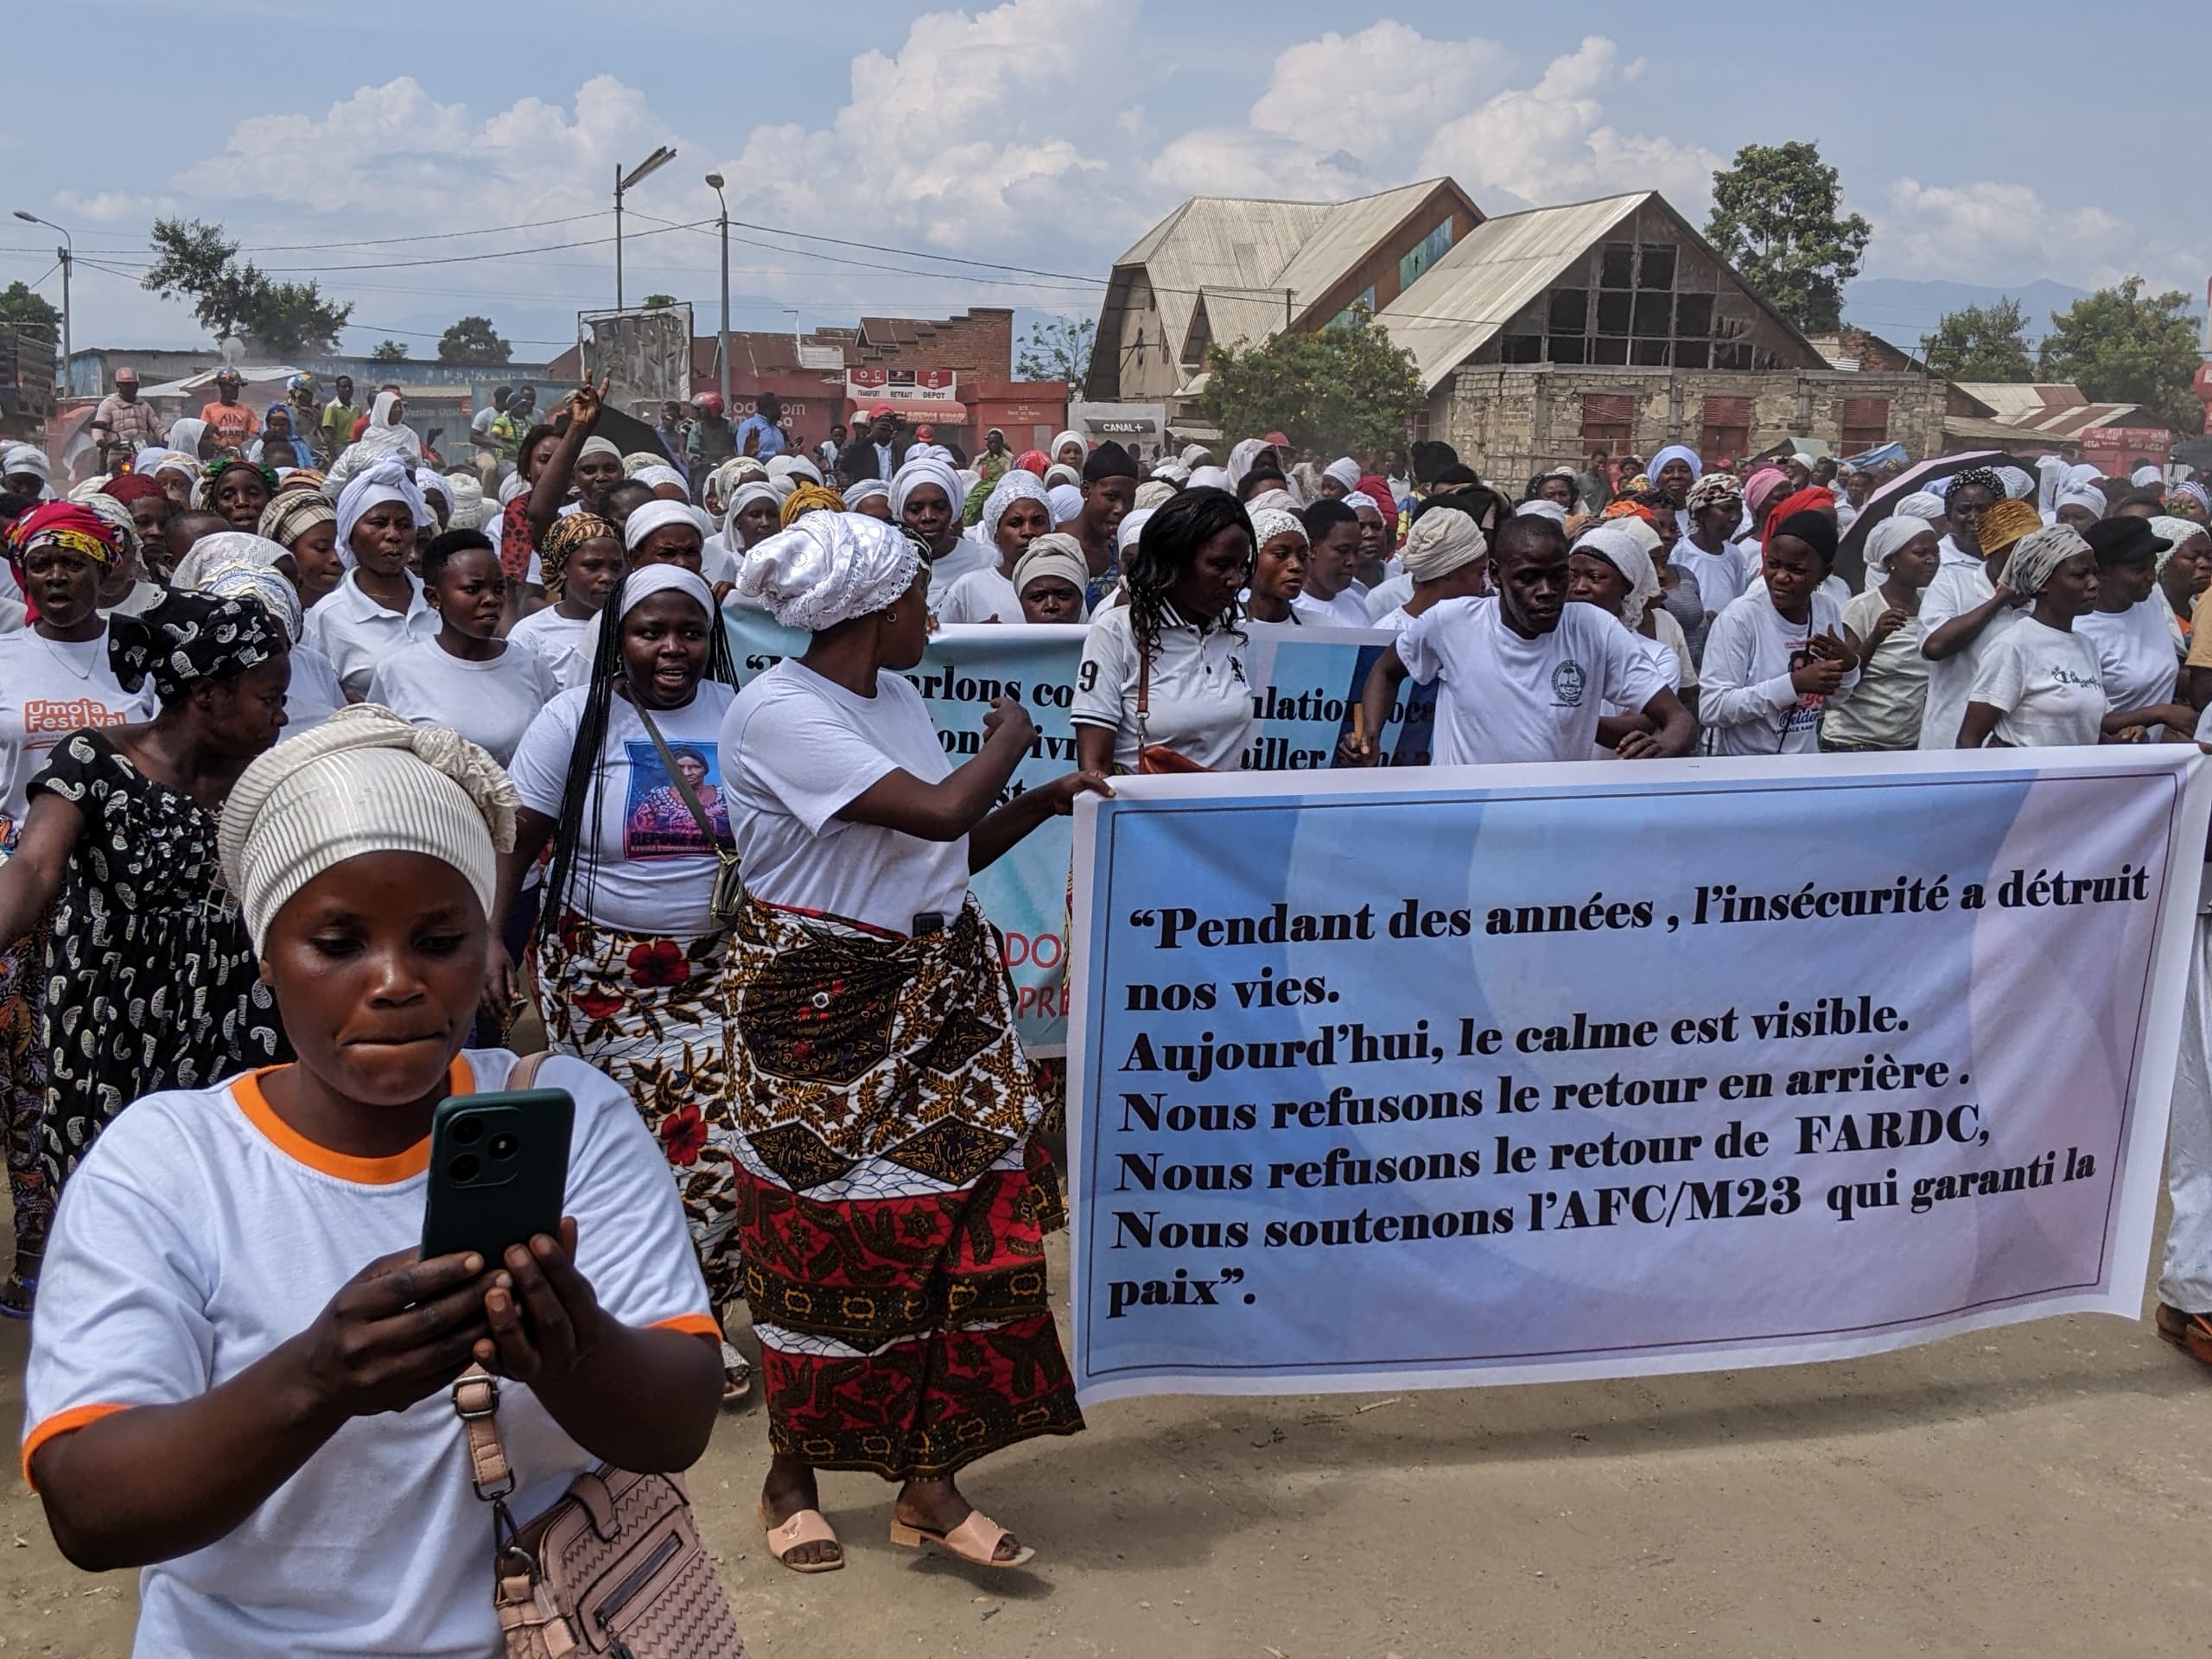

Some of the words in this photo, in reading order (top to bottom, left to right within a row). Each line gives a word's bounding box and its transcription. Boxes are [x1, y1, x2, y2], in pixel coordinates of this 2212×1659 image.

[1103, 423, 1144, 433] CANAL+
[1078, 660, 1099, 692] 9
[29, 701, 104, 721] Umoja
[1129, 902, 1376, 950] “Pendant
[1389, 899, 1471, 939] des
[1485, 892, 1654, 935] années
[1691, 874, 1949, 925] l’insécurité
[1960, 883, 1986, 910] a
[1998, 863, 2150, 908] détruit
[1123, 982, 1217, 1012] nos
[1230, 966, 1340, 1009] vies.
[1116, 1019, 1444, 1083] Aujourd’hui,
[1456, 1018, 1503, 1057] le
[1516, 1012, 1658, 1053] calme
[1670, 1007, 1739, 1046] est
[1750, 995, 1909, 1040] visible.
[1116, 1092, 1257, 1133] Nous
[1270, 1086, 1483, 1129] refusons
[1496, 1075, 1540, 1115] le
[1551, 1072, 1708, 1110] retour
[1719, 1073, 1773, 1101] en
[1785, 1053, 1949, 1096] arrière
[1112, 1152, 1253, 1192] Nous
[1266, 1147, 1480, 1190] refusons
[1493, 1135, 1536, 1175] le
[1548, 1131, 1702, 1171] retour
[1714, 1120, 1769, 1160] de
[1795, 1104, 1990, 1155] FARDC,
[1109, 1211, 1249, 1249] Nous
[1263, 1206, 1514, 1248] soutenons
[1527, 1176, 1802, 1231] l’AFC/M23
[1827, 1168, 1899, 1222] qui
[1910, 1150, 2056, 1214] garanti
[2062, 1147, 2096, 1182] la
[1105, 1268, 1256, 1320] paix”.
